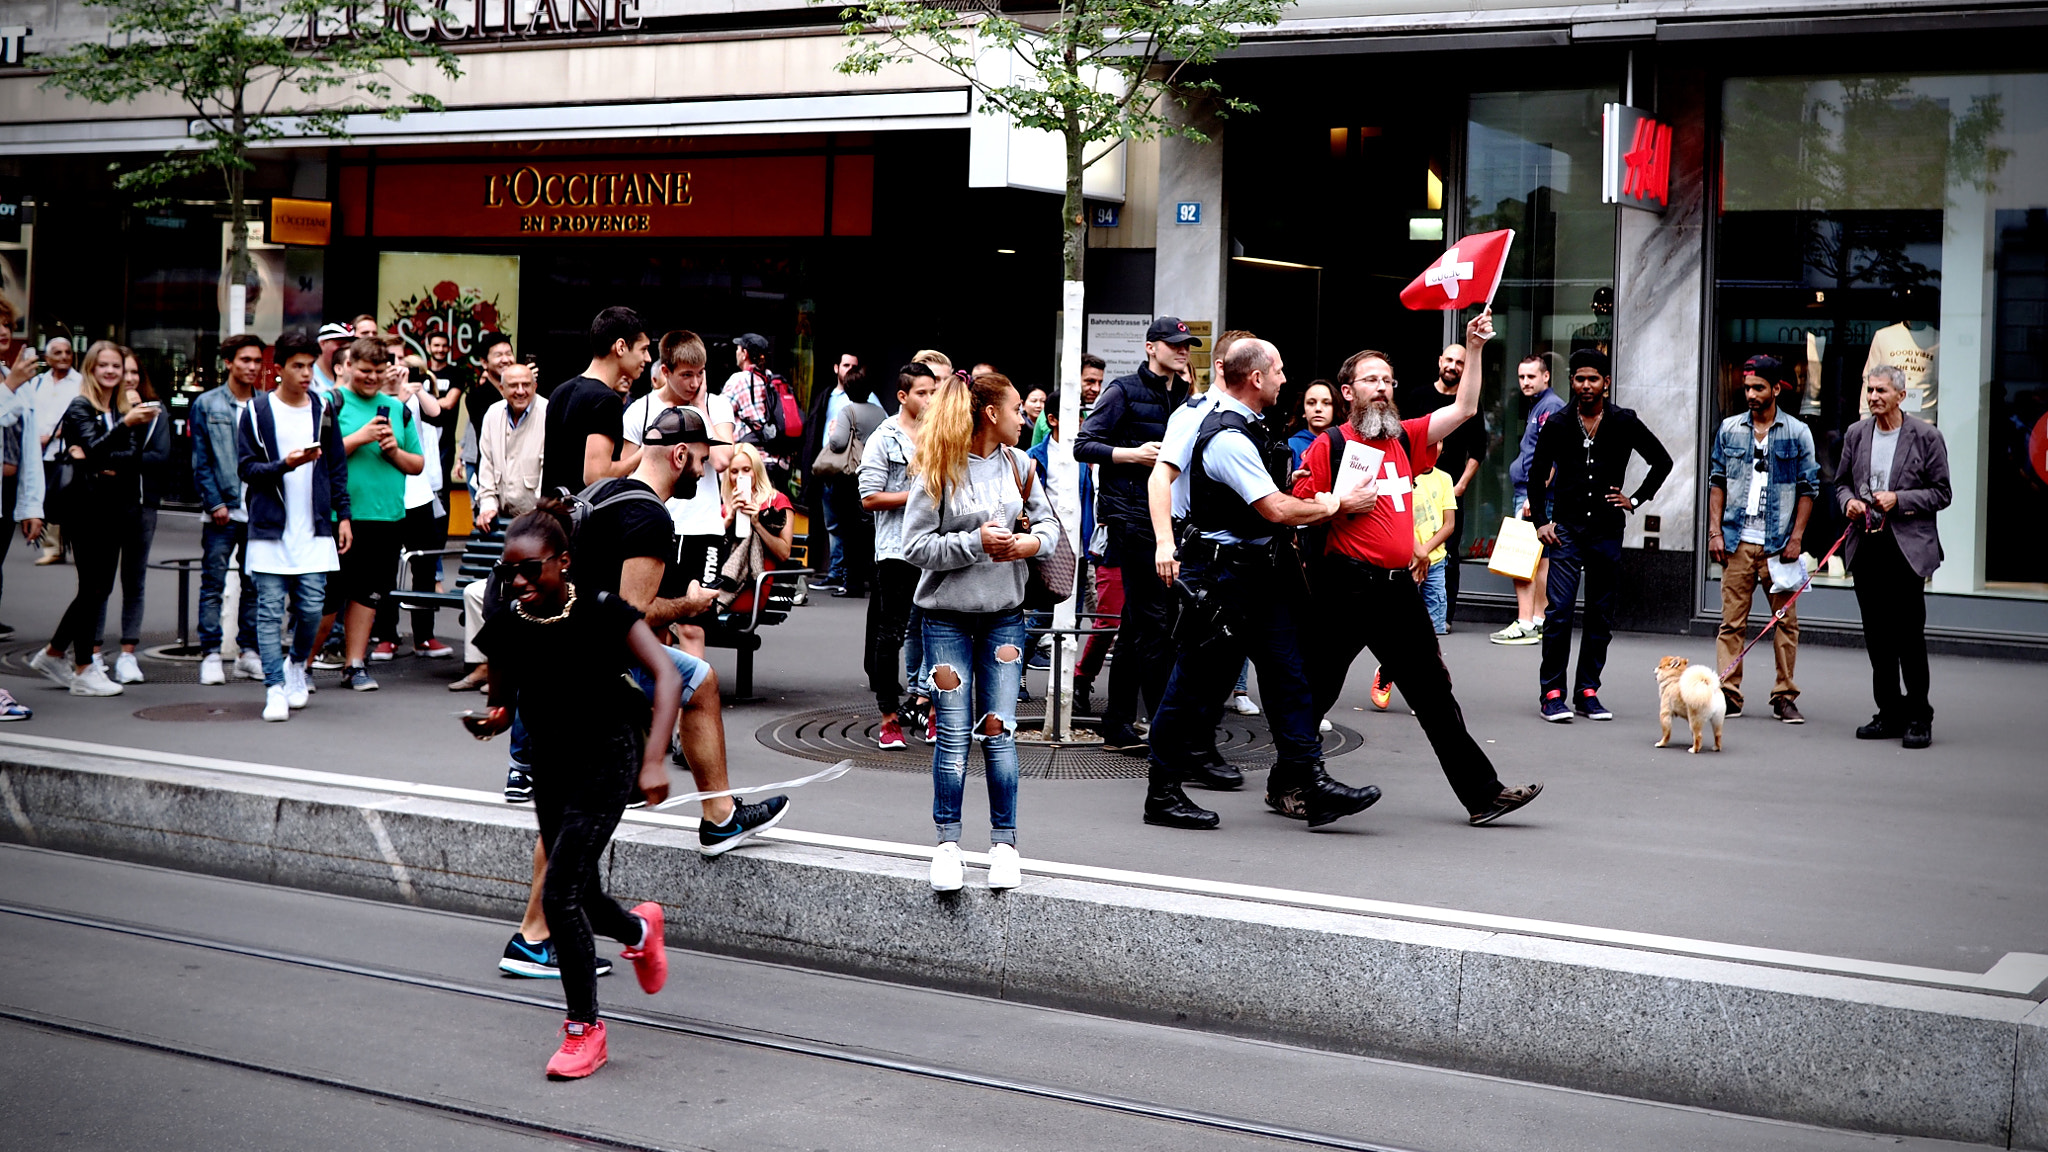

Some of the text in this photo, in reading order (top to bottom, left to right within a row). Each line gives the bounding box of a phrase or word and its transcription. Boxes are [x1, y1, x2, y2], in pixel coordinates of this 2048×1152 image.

[302, 0, 641, 47] LOCCITANE
[483, 165, 693, 209] L'OCCITANE
[1098, 208, 1113, 223] 94
[1180, 204, 1196, 221] 92
[519, 213, 651, 233] EN PROVENCE
[1090, 318, 1140, 326] Bahnhofstrasse
[1915, 350, 1934, 361] VIBES
[1910, 365, 1927, 373] WAY
[1349, 460, 1370, 472] Bibel
